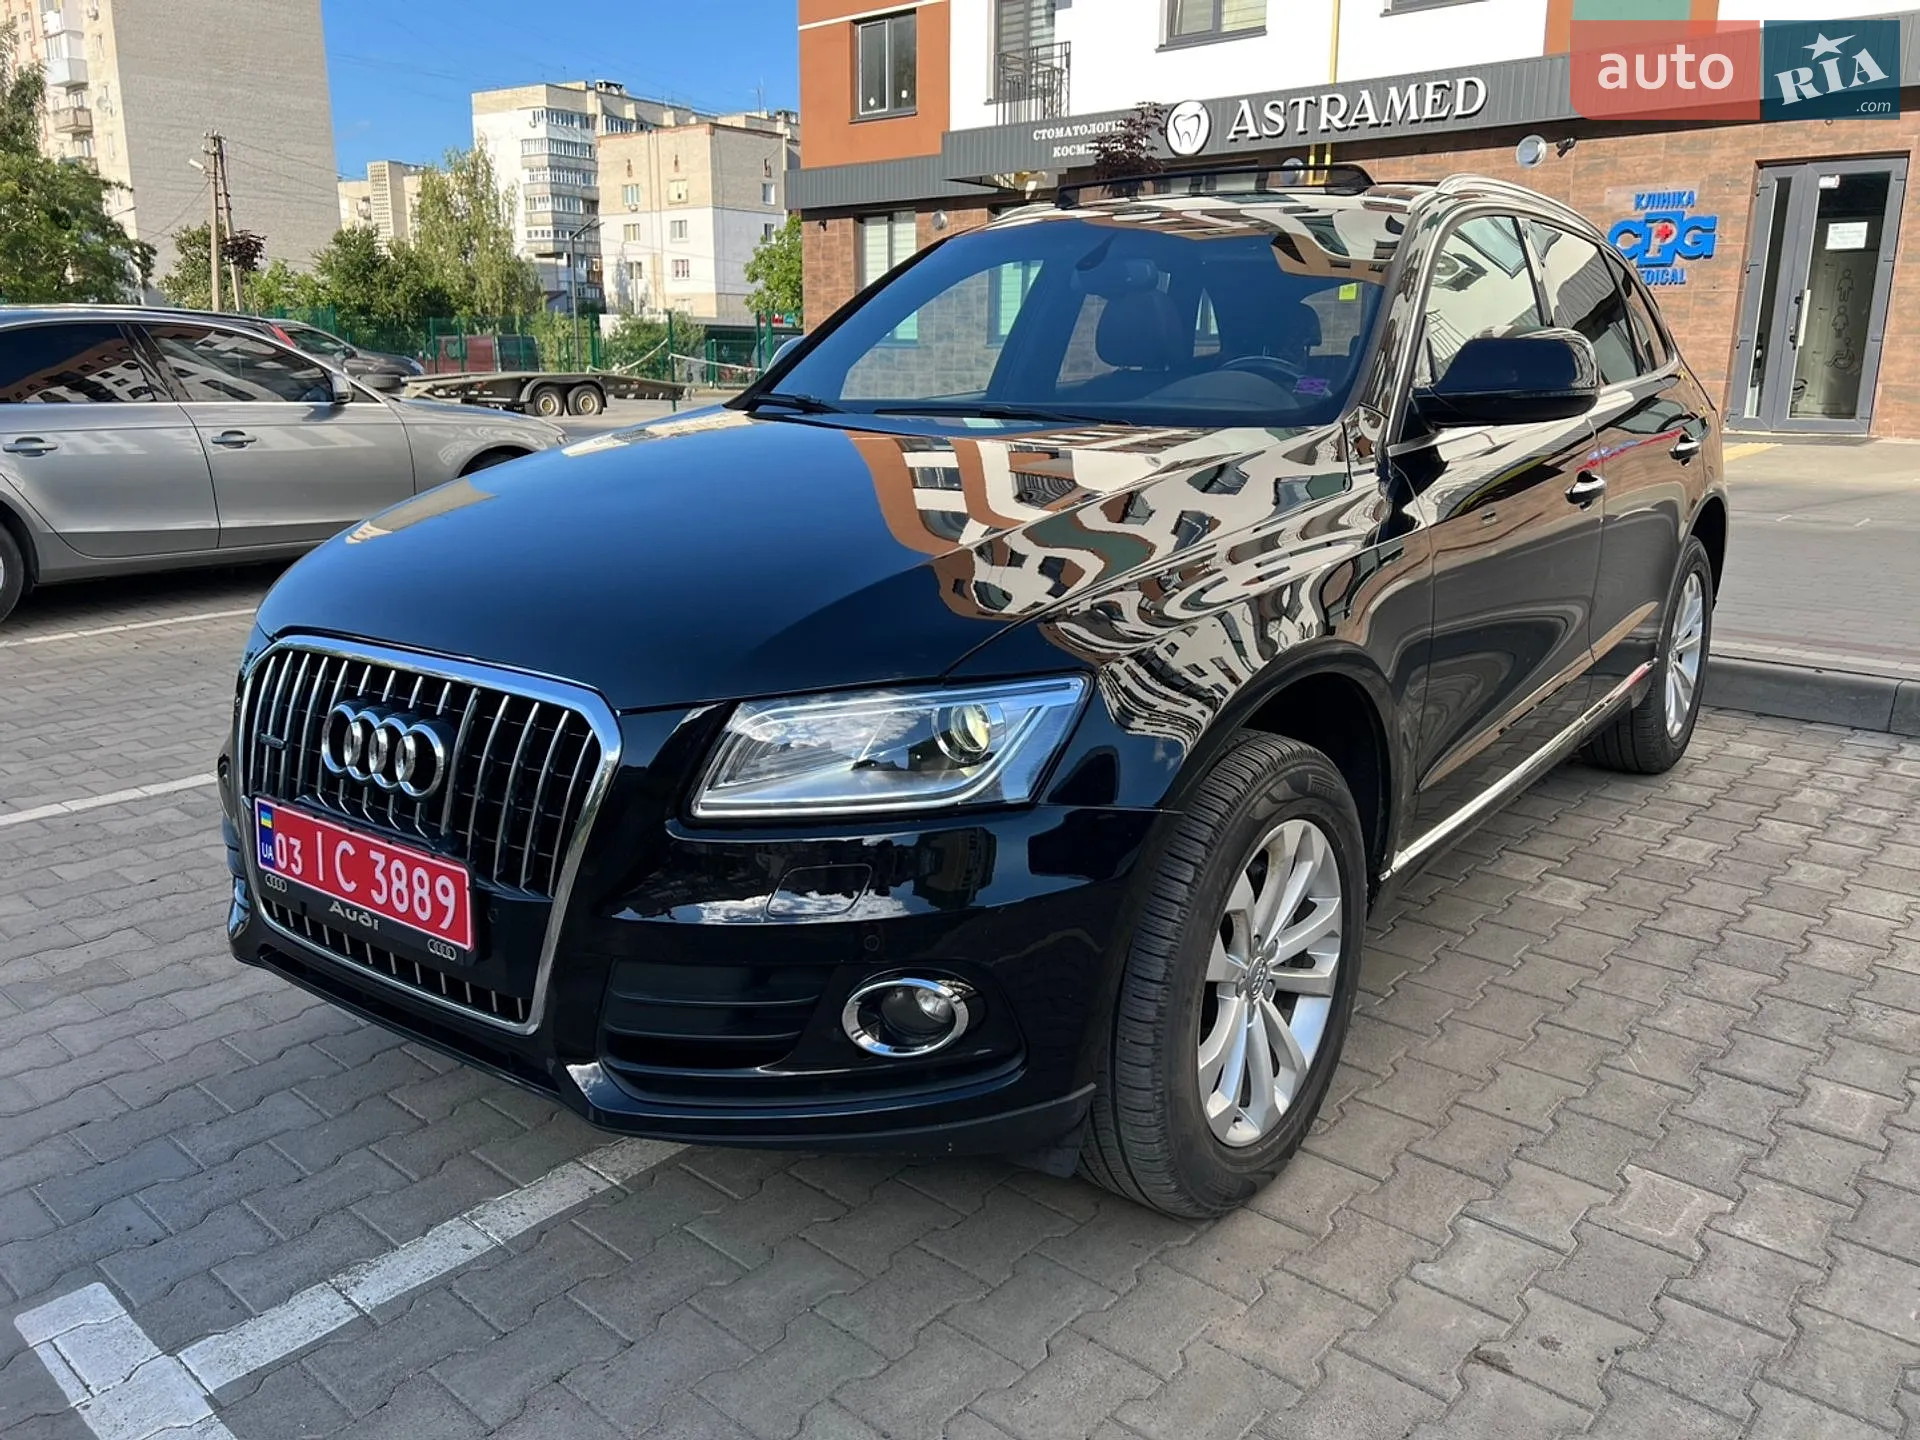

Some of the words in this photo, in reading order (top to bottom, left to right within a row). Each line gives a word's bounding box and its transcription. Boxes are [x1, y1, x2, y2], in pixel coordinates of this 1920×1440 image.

[1227, 76, 1487, 142] ASTRAMED
[1640, 269, 1686, 286] DICAL
[261, 841, 274, 861] UA
[275, 832, 303, 875] 03
[369, 849, 456, 930] 3889
[328, 900, 379, 931] Audi
